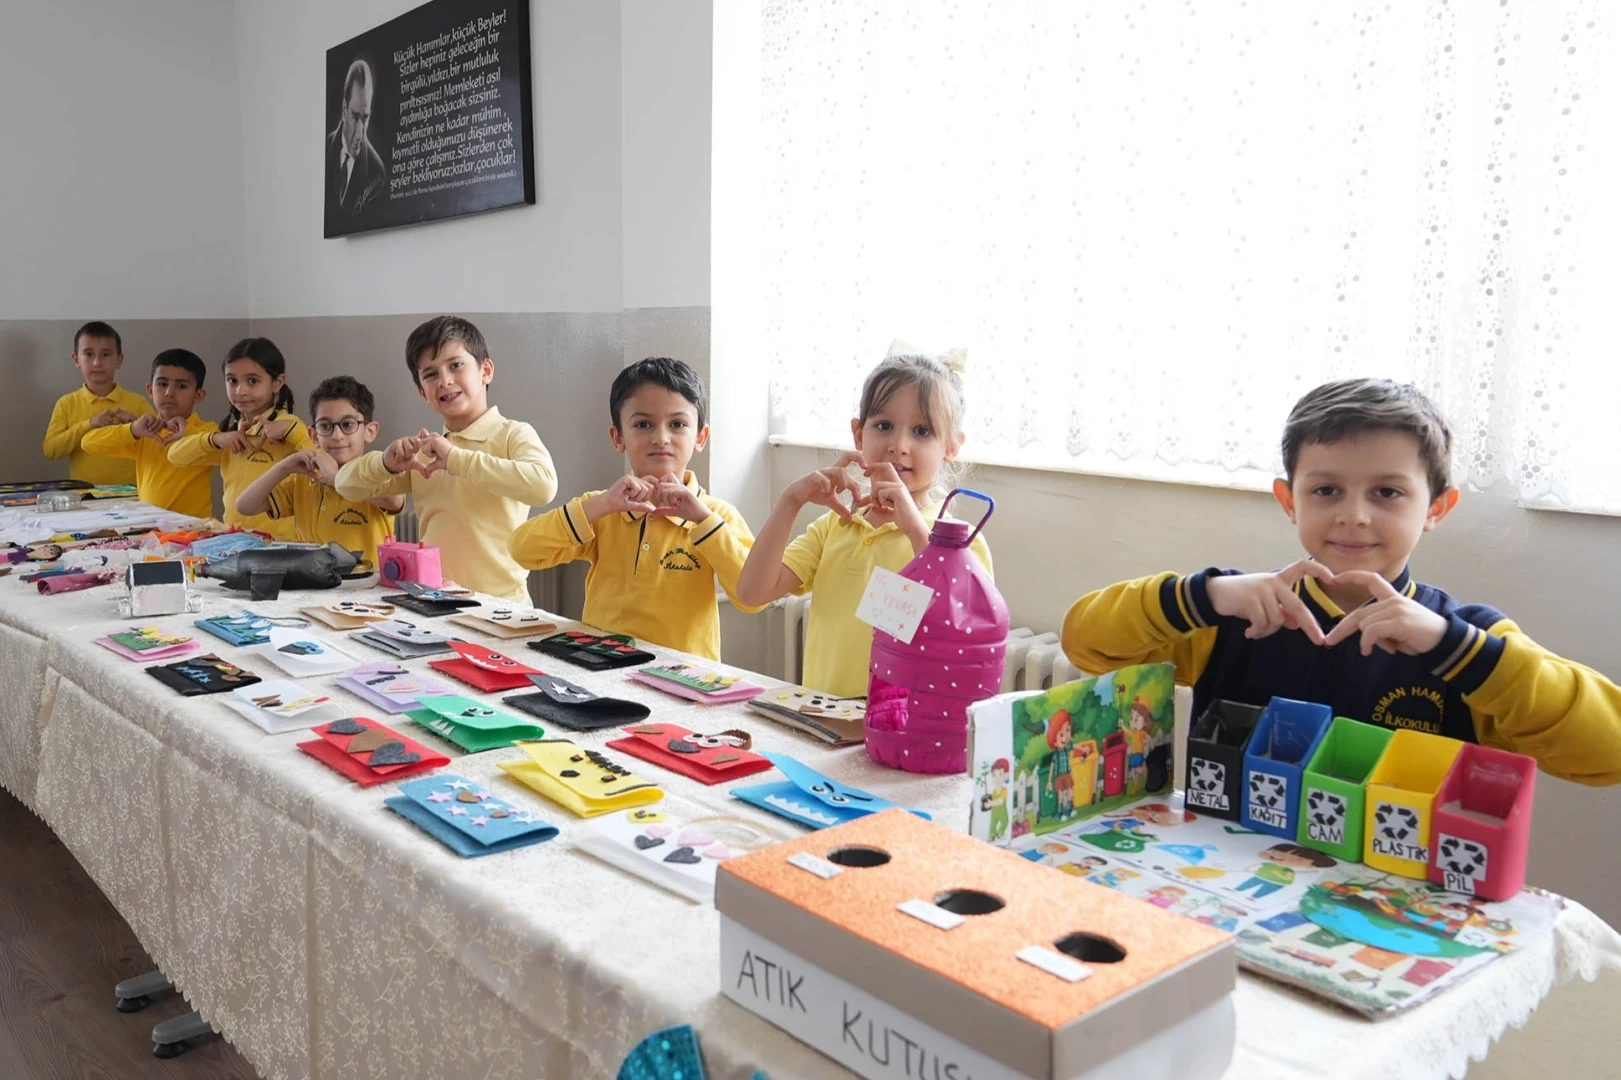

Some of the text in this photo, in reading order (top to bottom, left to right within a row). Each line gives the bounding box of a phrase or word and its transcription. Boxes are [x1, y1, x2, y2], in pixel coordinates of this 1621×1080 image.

[478, 9, 507, 32] Beyler!
[399, 61, 419, 77] Sizler
[420, 51, 447, 70] hepiniz
[487, 28, 500, 44] bir
[462, 48, 500, 73] mutluluk
[444, 72, 485, 98] Memleketi
[486, 67, 501, 83] asıl
[434, 96, 467, 116] boğacak
[396, 123, 434, 144] Kendinizin
[435, 123, 445, 134] ne
[446, 114, 470, 131] kadar
[421, 131, 466, 152] olduğunuzu
[468, 118, 513, 141] düşünerek
[392, 163, 406, 174] ona
[407, 157, 424, 174] göre
[497, 134, 514, 152] çok
[390, 174, 411, 192] şeyler
[1371, 686, 1407, 722] OSMAN
[1307, 823, 1344, 845] CAM
[737, 949, 807, 1013] ATIK
